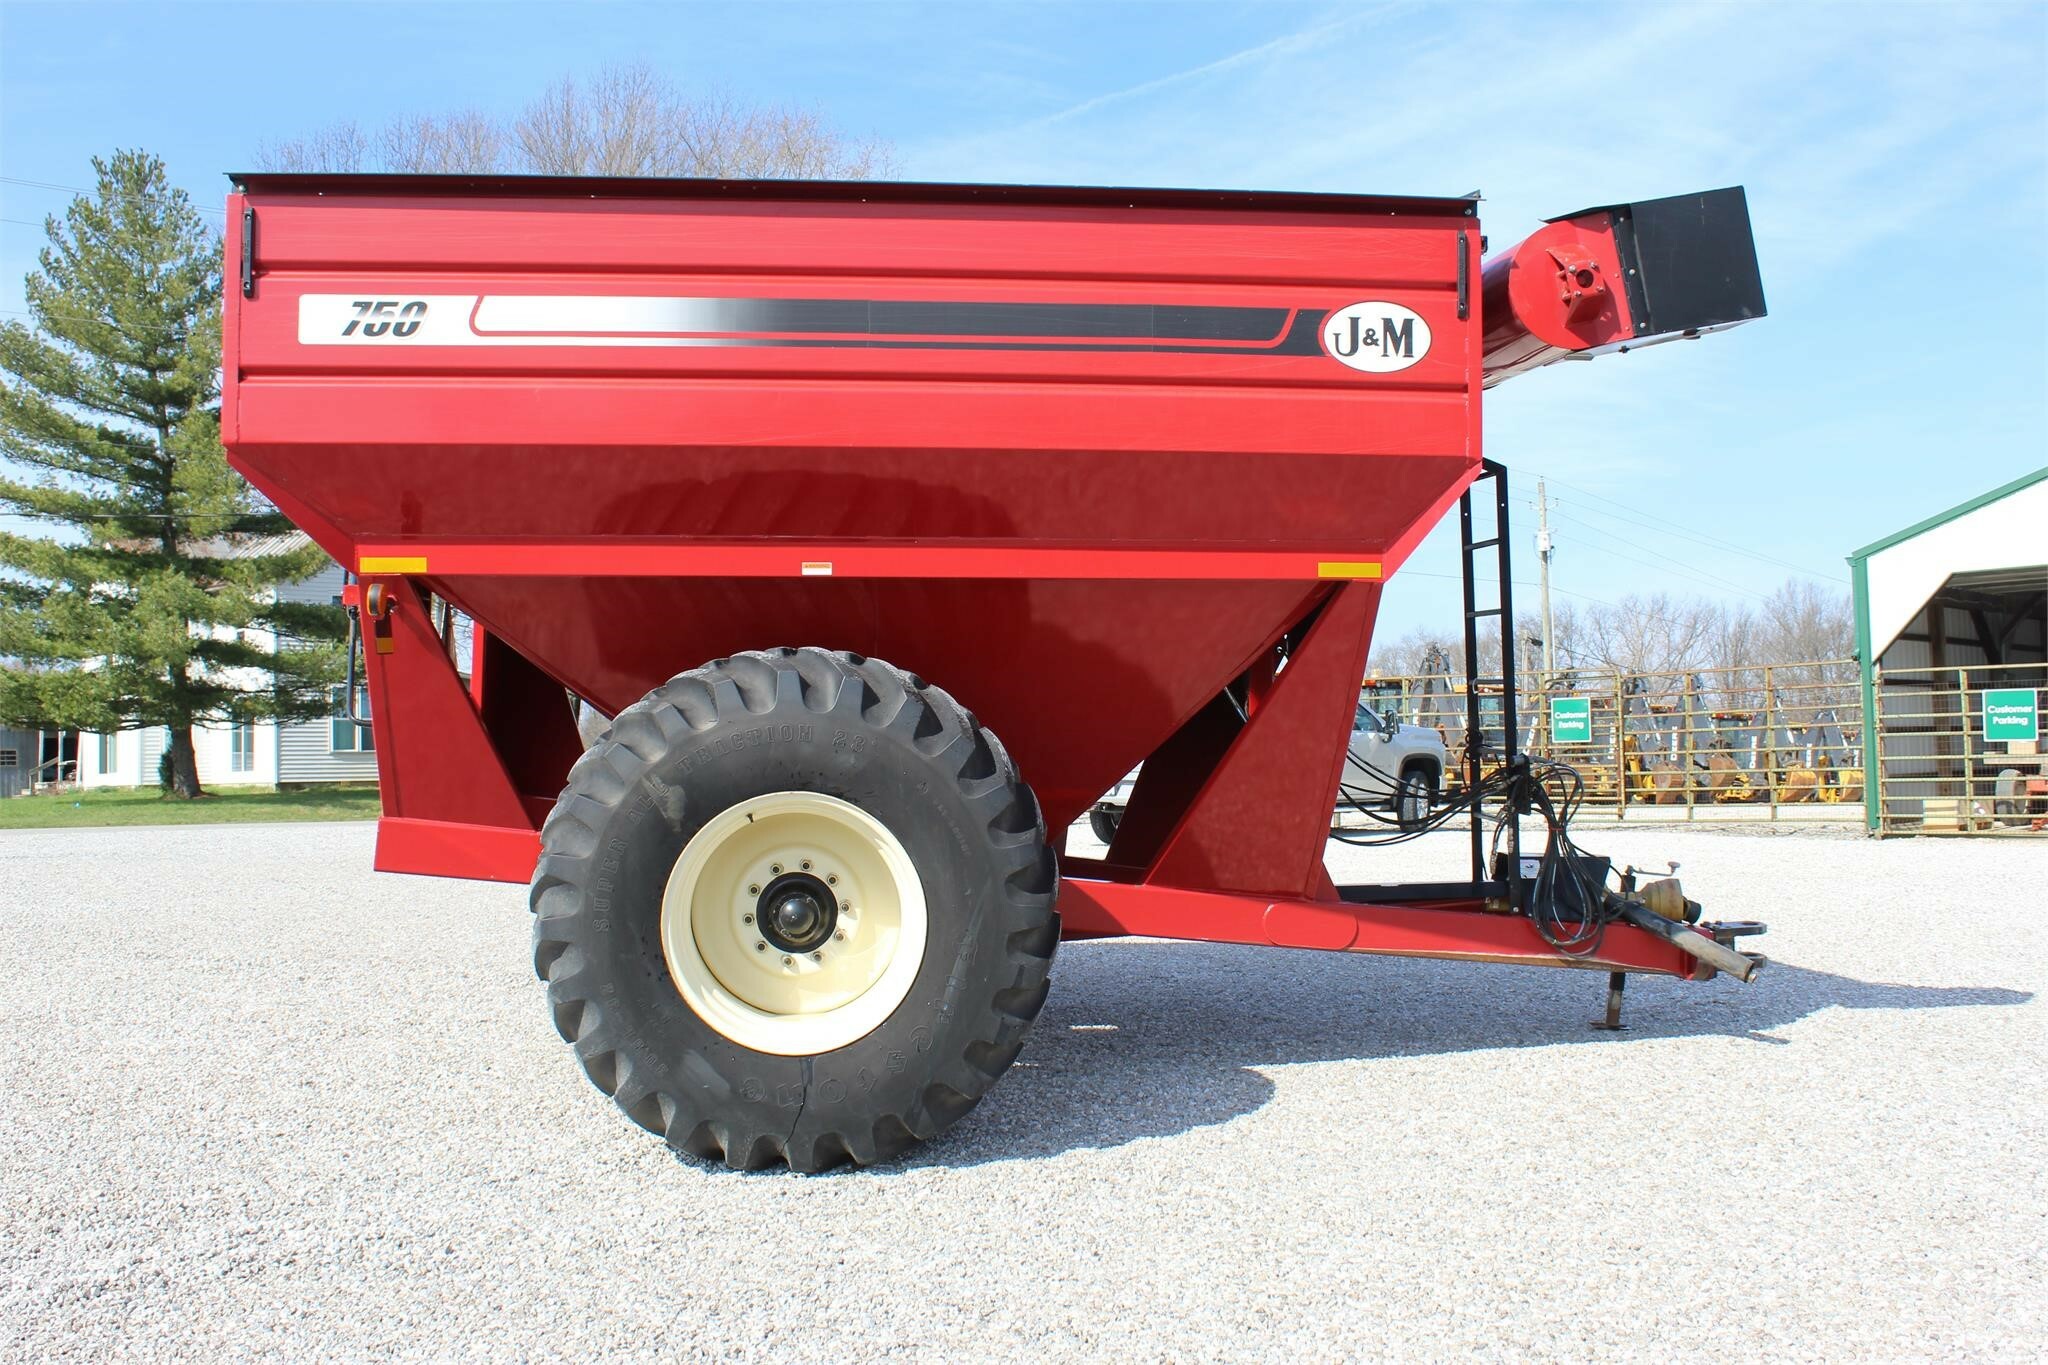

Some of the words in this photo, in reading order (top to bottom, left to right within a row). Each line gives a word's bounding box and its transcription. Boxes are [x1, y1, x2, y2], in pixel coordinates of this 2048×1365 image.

[341, 301, 428, 337] 750
[1332, 316, 1416, 358] J&M
[1987, 705, 2033, 713] Customer
[1992, 716, 2028, 726] Parking
[592, 838, 629, 932] SUPER
[673, 724, 814, 776] TRACTION
